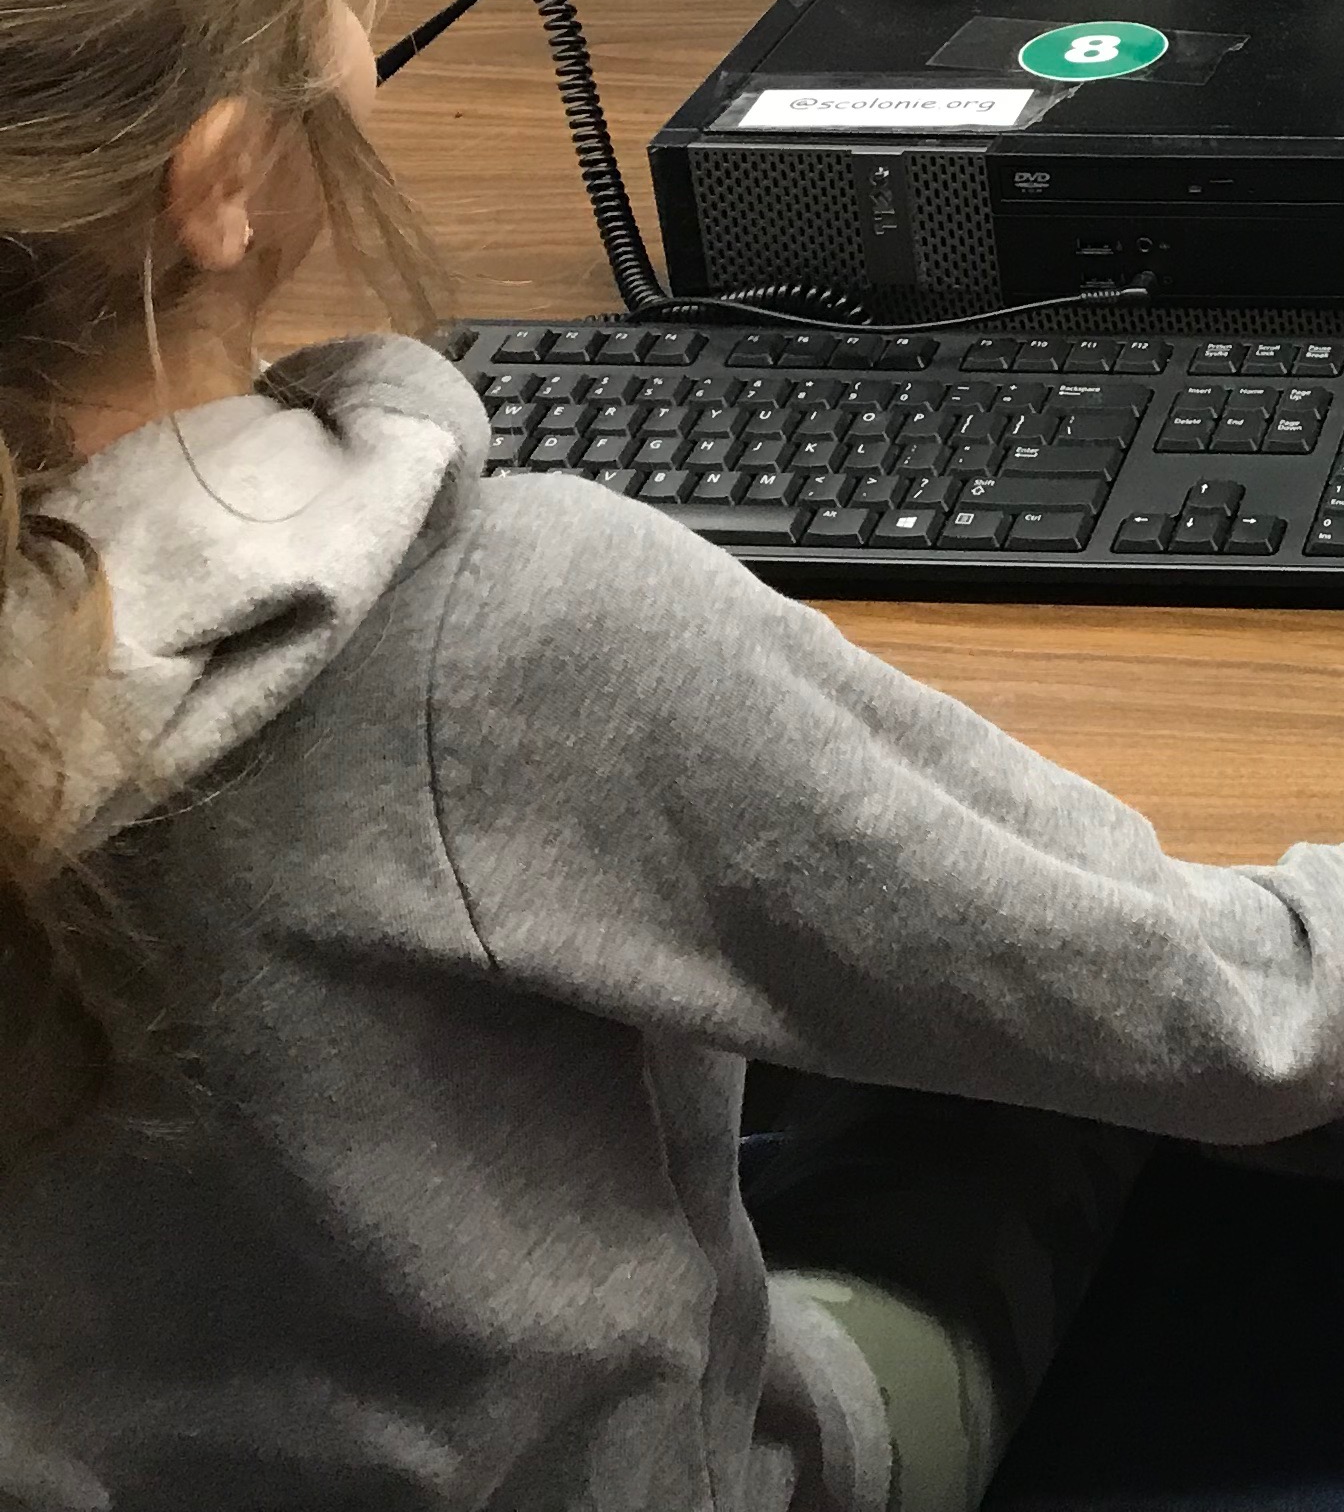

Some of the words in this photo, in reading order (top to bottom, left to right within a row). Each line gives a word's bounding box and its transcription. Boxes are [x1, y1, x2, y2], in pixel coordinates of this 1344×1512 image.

[1065, 35, 1121, 63] 8
[789, 96, 996, 113] @scolonie.org
[1014, 172, 1050, 182] DVD
[645, 388, 653, 396] 5
[696, 389, 704, 397] 6
[1059, 385, 1100, 393] Backspace
[747, 390, 755, 398] 7
[797, 391, 806, 399] 8
[505, 406, 522, 415] W
[554, 406, 564, 416] E
[604, 407, 616, 416] R
[658, 408, 669, 417] T
[711, 409, 722, 418] Y
[759, 410, 772, 420] U
[863, 412, 875, 421] O
[914, 413, 924, 421] P
[492, 437, 504, 446] S
[545, 438, 558, 447] D
[596, 438, 608, 448] F
[650, 440, 662, 449] G
[701, 441, 714, 450] H
[752, 442, 762, 451] J
[805, 443, 818, 452] K
[857, 444, 865, 453] L
[604, 472, 617, 481] V
[654, 473, 666, 482] B
[708, 474, 721, 483] N
[760, 475, 776, 484] M
[1336, 485, 1342, 493] 1
[1323, 519, 1331, 527] 0
